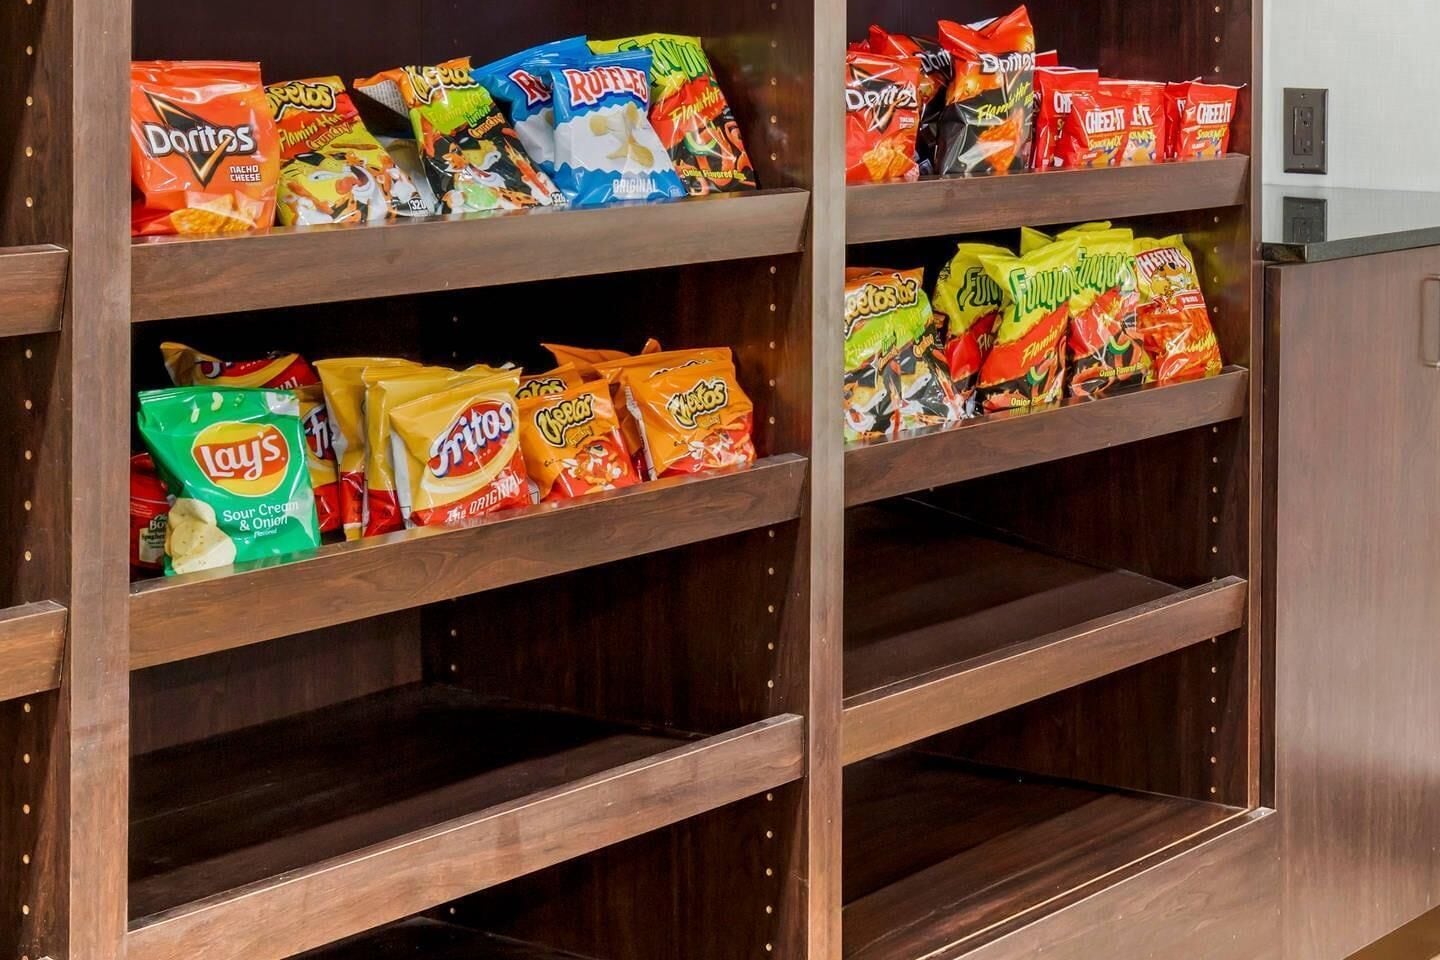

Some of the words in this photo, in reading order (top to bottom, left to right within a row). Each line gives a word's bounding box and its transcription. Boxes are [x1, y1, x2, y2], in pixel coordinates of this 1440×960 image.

[562, 66, 647, 106] RUFFLES
[1085, 108, 1124, 134] CHEEZ-IT
[145, 124, 254, 155] Doritos
[230, 173, 260, 182] CHEESE
[612, 178, 656, 193] ORIGINAL
[1009, 267, 1075, 321] FUNYUN
[536, 395, 594, 447] Cheetos
[666, 380, 727, 428] Cheetos
[200, 431, 281, 481] Lay's
[429, 402, 514, 478] Fritos
[223, 509, 255, 522] Sour
[259, 501, 299, 516] Cream
[240, 519, 250, 531] &
[253, 515, 287, 529] Onion
